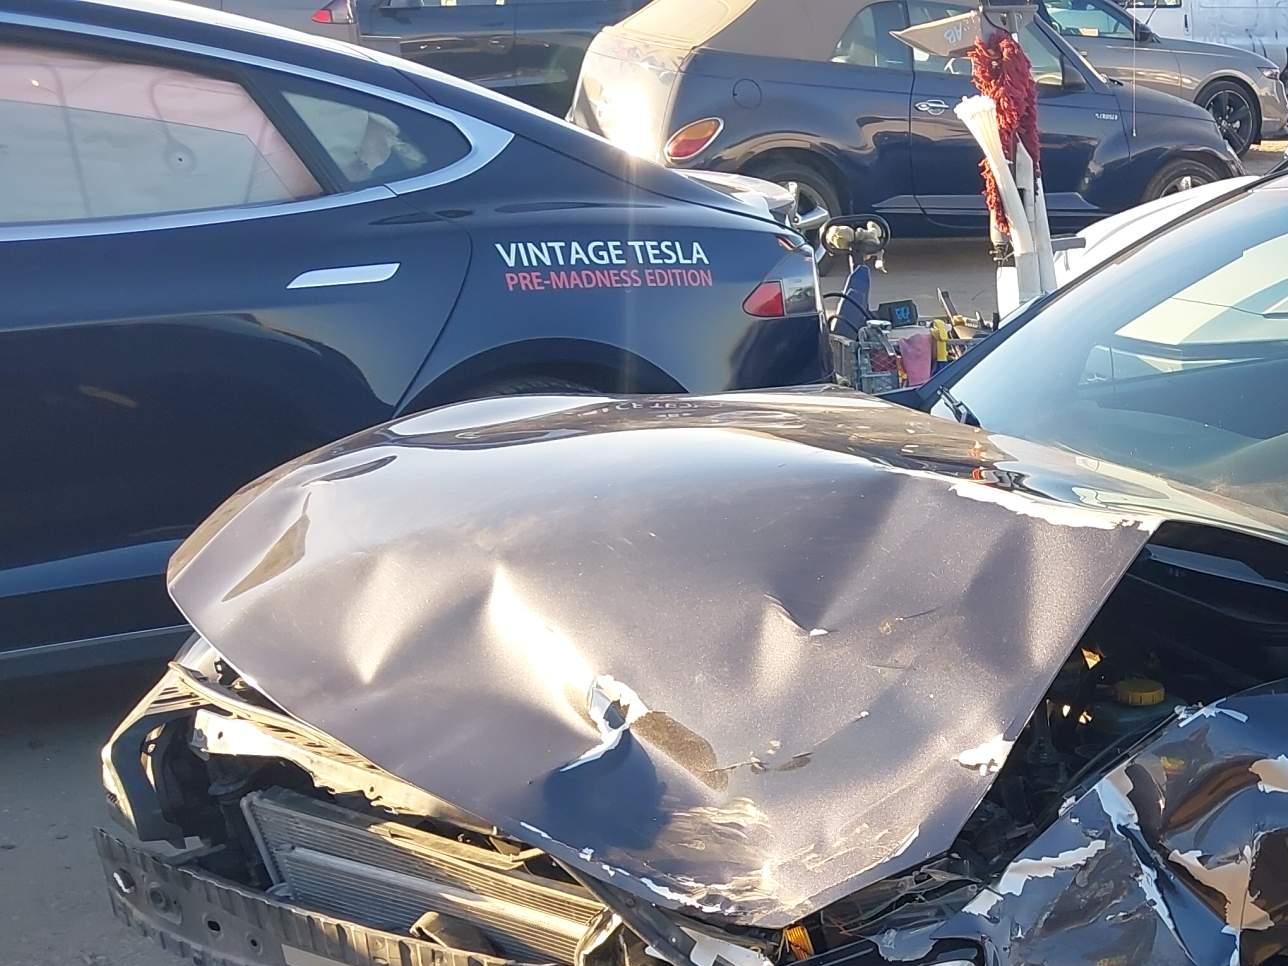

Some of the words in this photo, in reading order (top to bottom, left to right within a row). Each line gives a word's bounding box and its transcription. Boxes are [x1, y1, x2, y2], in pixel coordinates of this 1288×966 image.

[495, 241, 627, 267] VINTAGE
[627, 241, 710, 265] TESLA
[505, 269, 642, 291] PRE-MADNESS
[645, 269, 713, 288] EDITION
